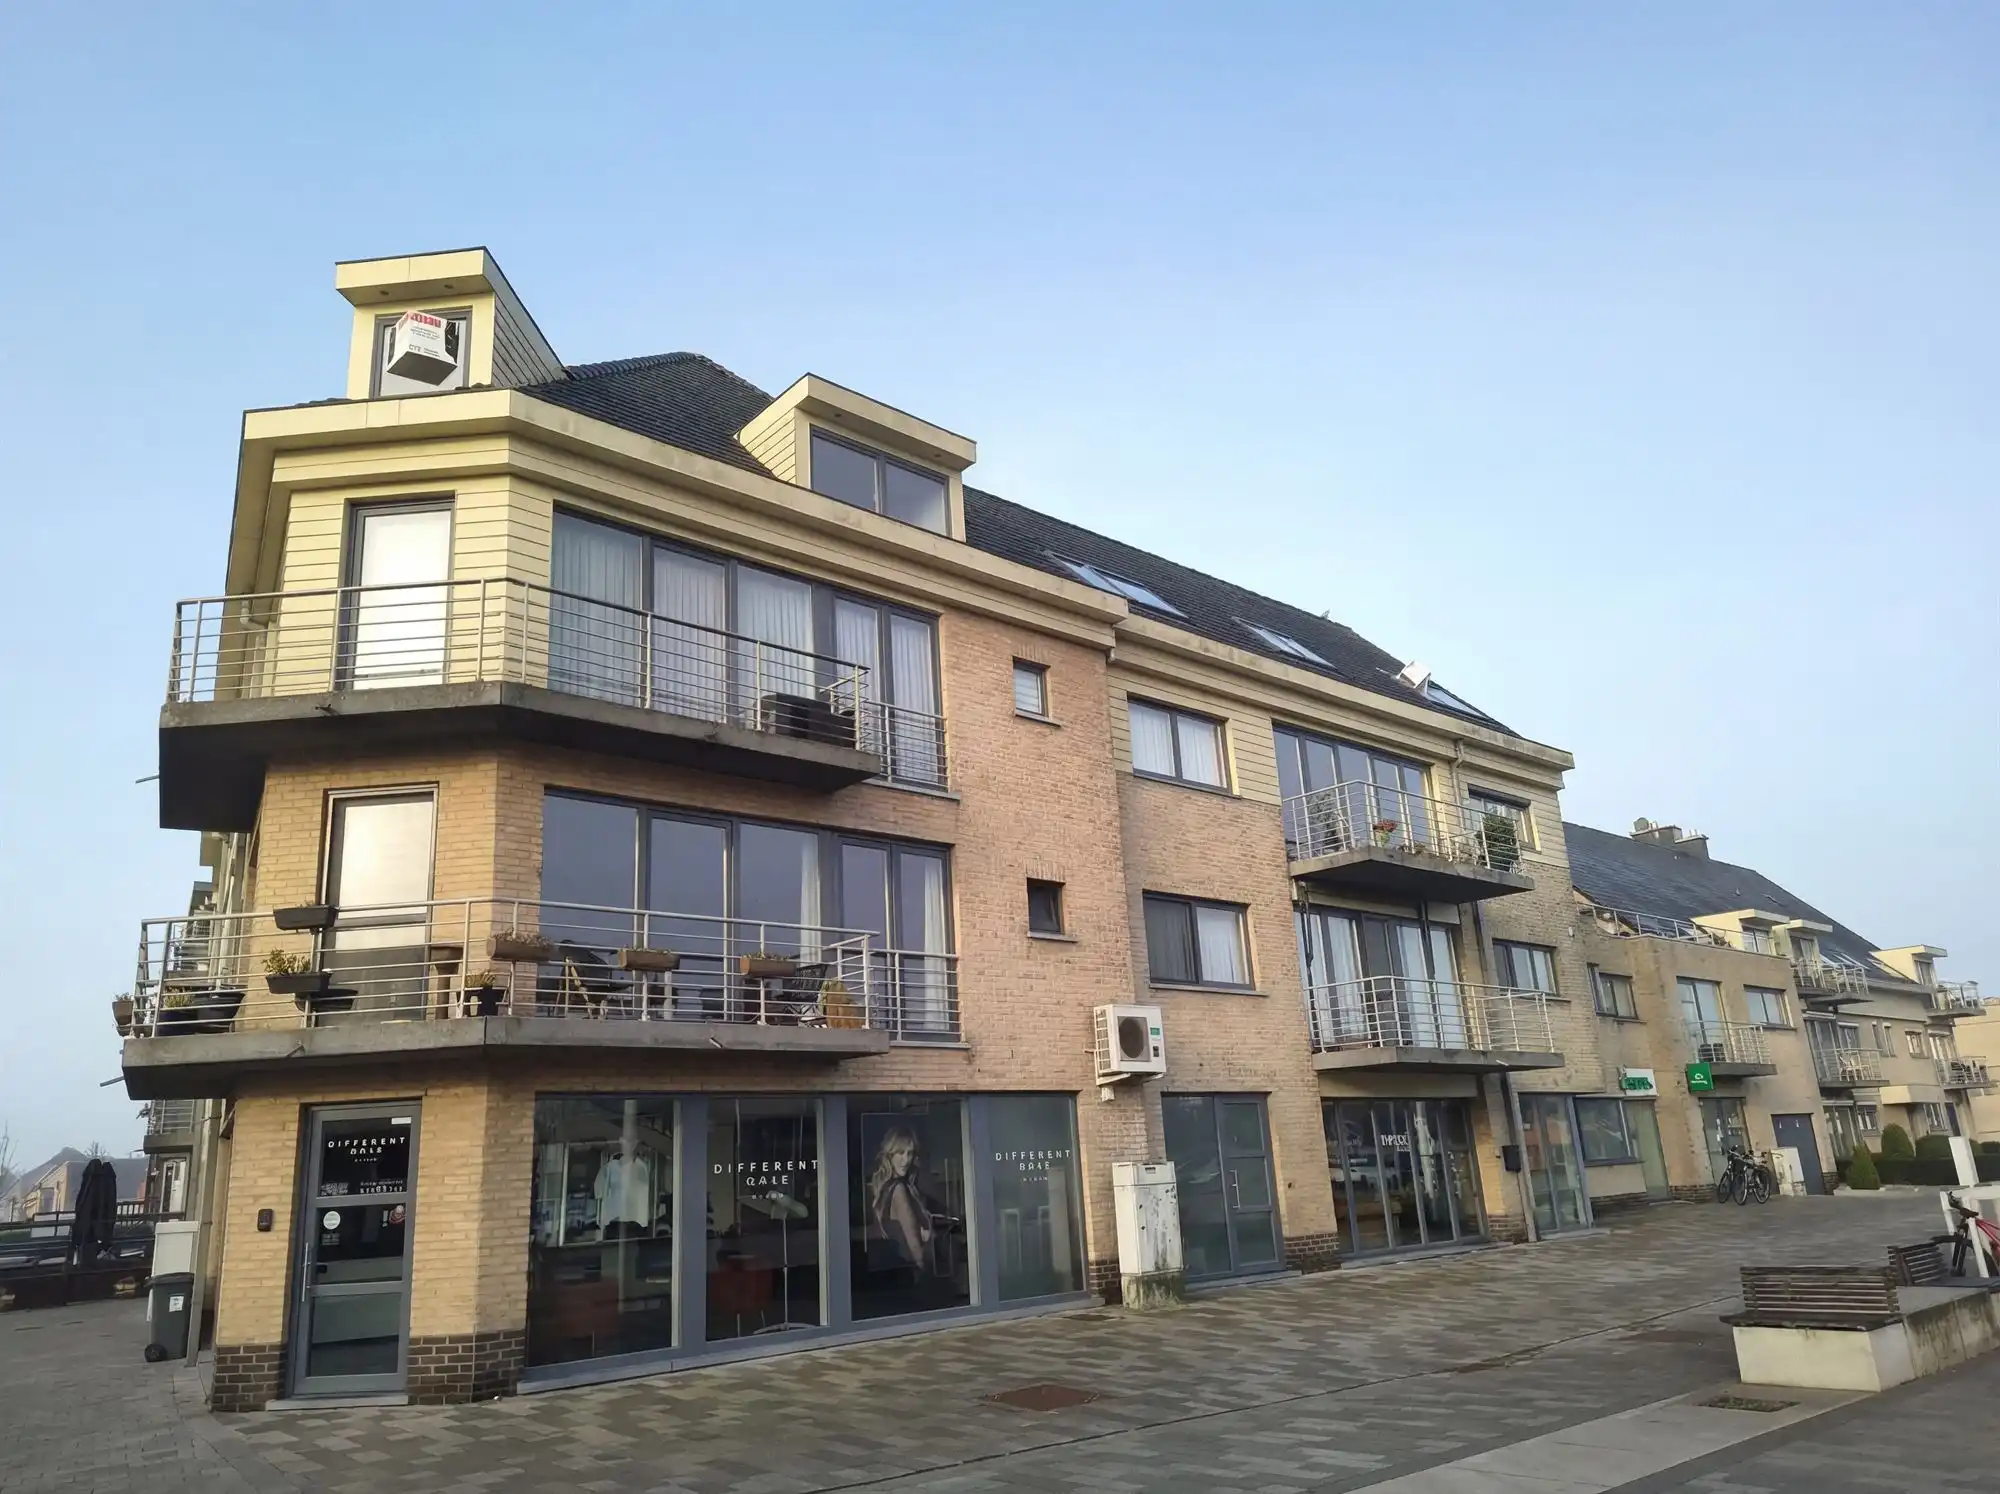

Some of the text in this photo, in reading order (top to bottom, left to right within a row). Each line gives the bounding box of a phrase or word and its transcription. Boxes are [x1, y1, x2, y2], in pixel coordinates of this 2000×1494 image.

[328, 1137, 405, 1148] DIFFERENT
[995, 1150, 1070, 1161] DIFFERENT
[714, 1160, 818, 1174] DIFFERENT
